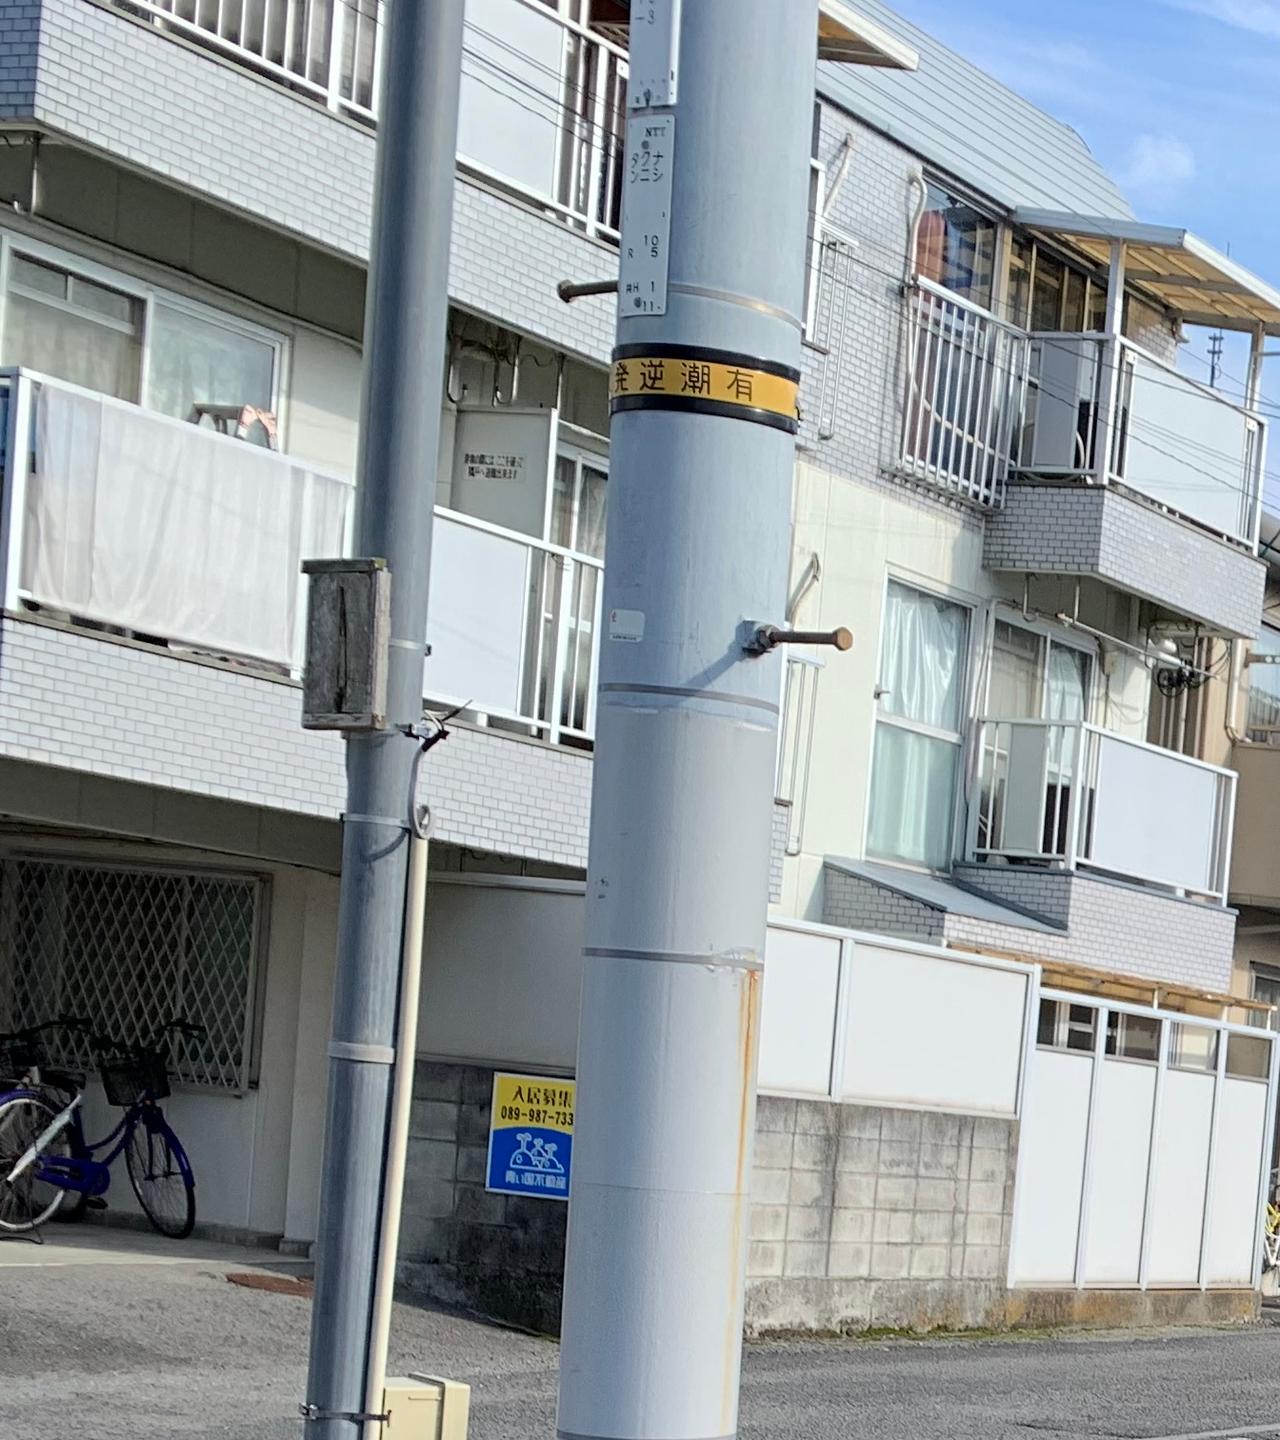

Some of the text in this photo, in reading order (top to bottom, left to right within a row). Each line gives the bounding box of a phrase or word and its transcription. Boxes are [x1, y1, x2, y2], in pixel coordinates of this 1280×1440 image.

[645, 126, 666, 137] NTT
[643, 234, 660, 246] 10
[650, 246, 659, 258] 5
